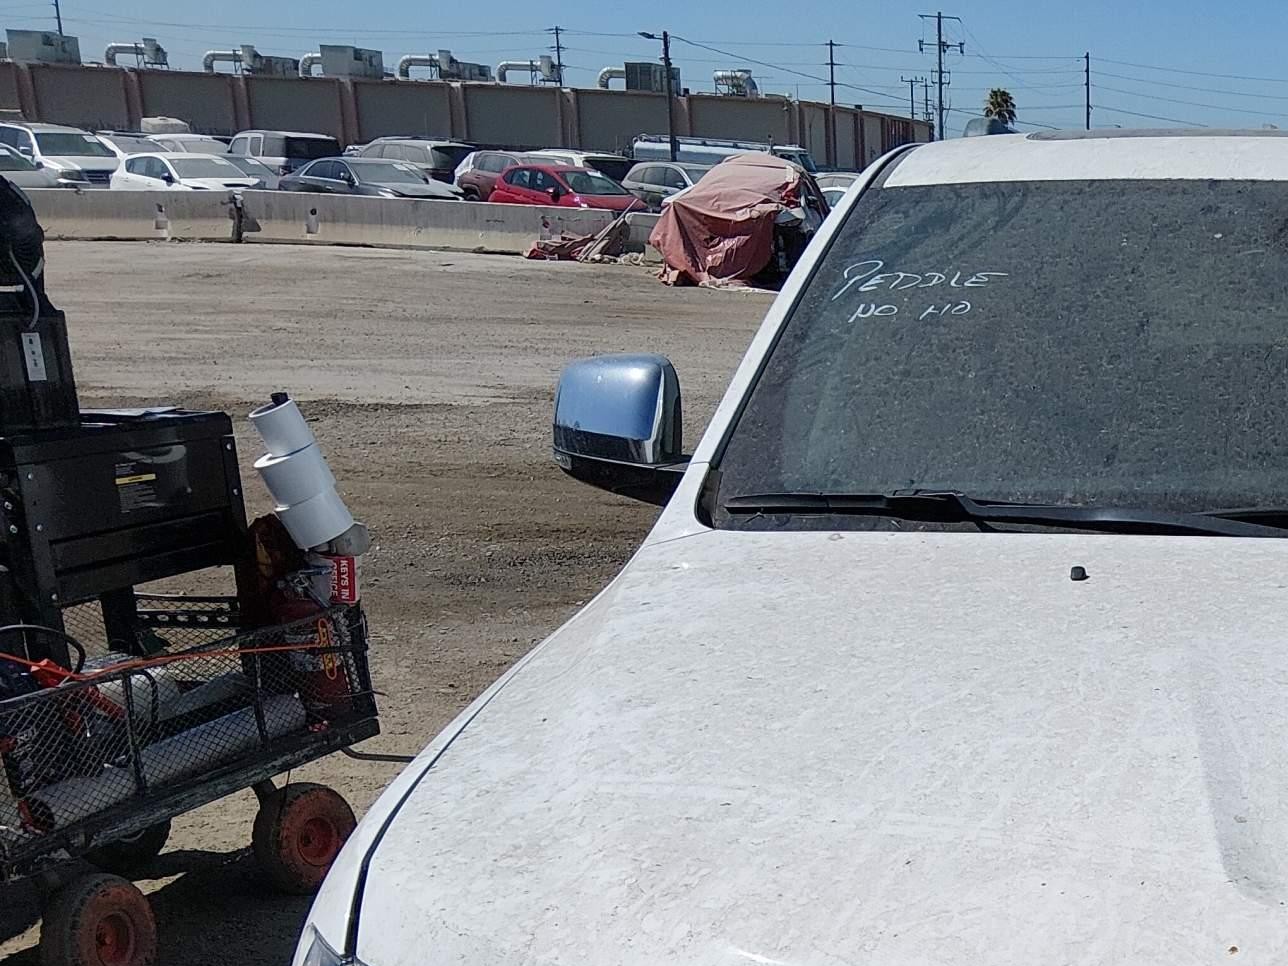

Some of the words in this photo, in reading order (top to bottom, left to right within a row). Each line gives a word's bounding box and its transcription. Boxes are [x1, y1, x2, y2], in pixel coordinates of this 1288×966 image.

[832, 260, 1009, 301] PEDDLE
[848, 303, 898, 323] NO
[341, 559, 350, 586] KEYS
[341, 588, 350, 600] IN
